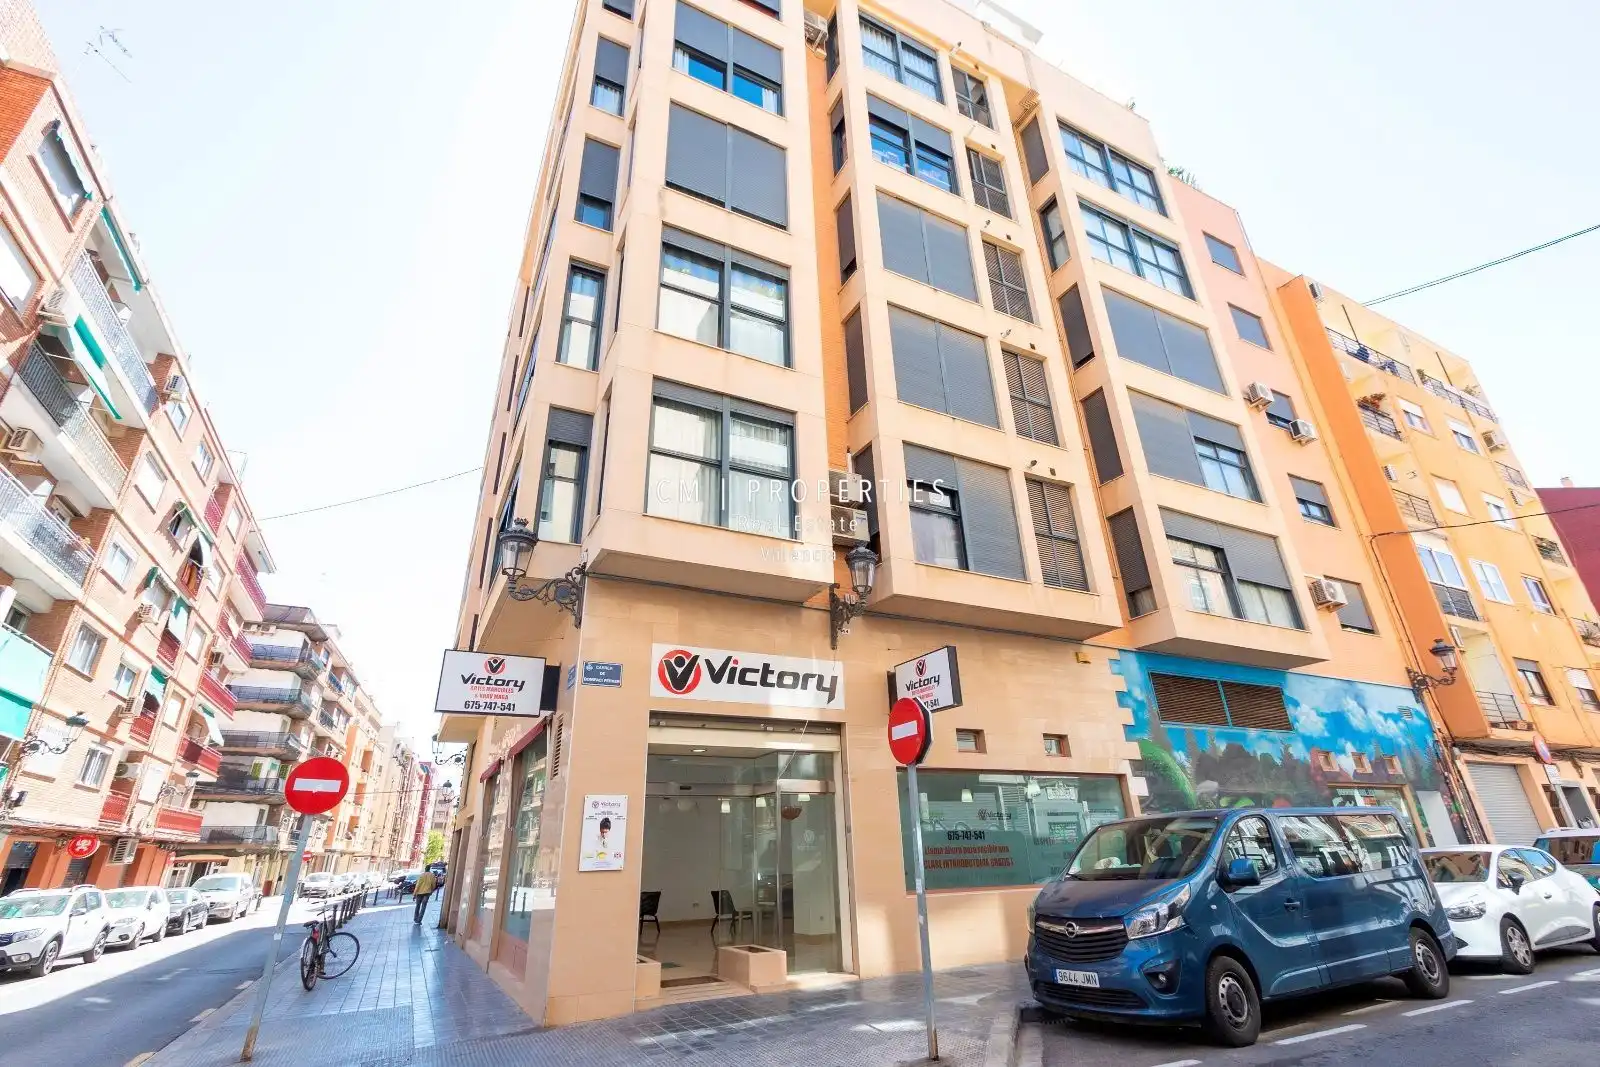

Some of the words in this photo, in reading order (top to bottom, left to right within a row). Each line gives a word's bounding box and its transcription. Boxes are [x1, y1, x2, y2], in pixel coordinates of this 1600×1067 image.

[461, 672, 526, 693] Victory
[704, 655, 839, 705] Victory
[905, 674, 941, 692] Victory
[464, 700, 516, 712] 675-747-541
[947, 830, 986, 841] 675-747-541
[1058, 970, 1079, 983] 9644
[1081, 972, 1098, 985] JMN
